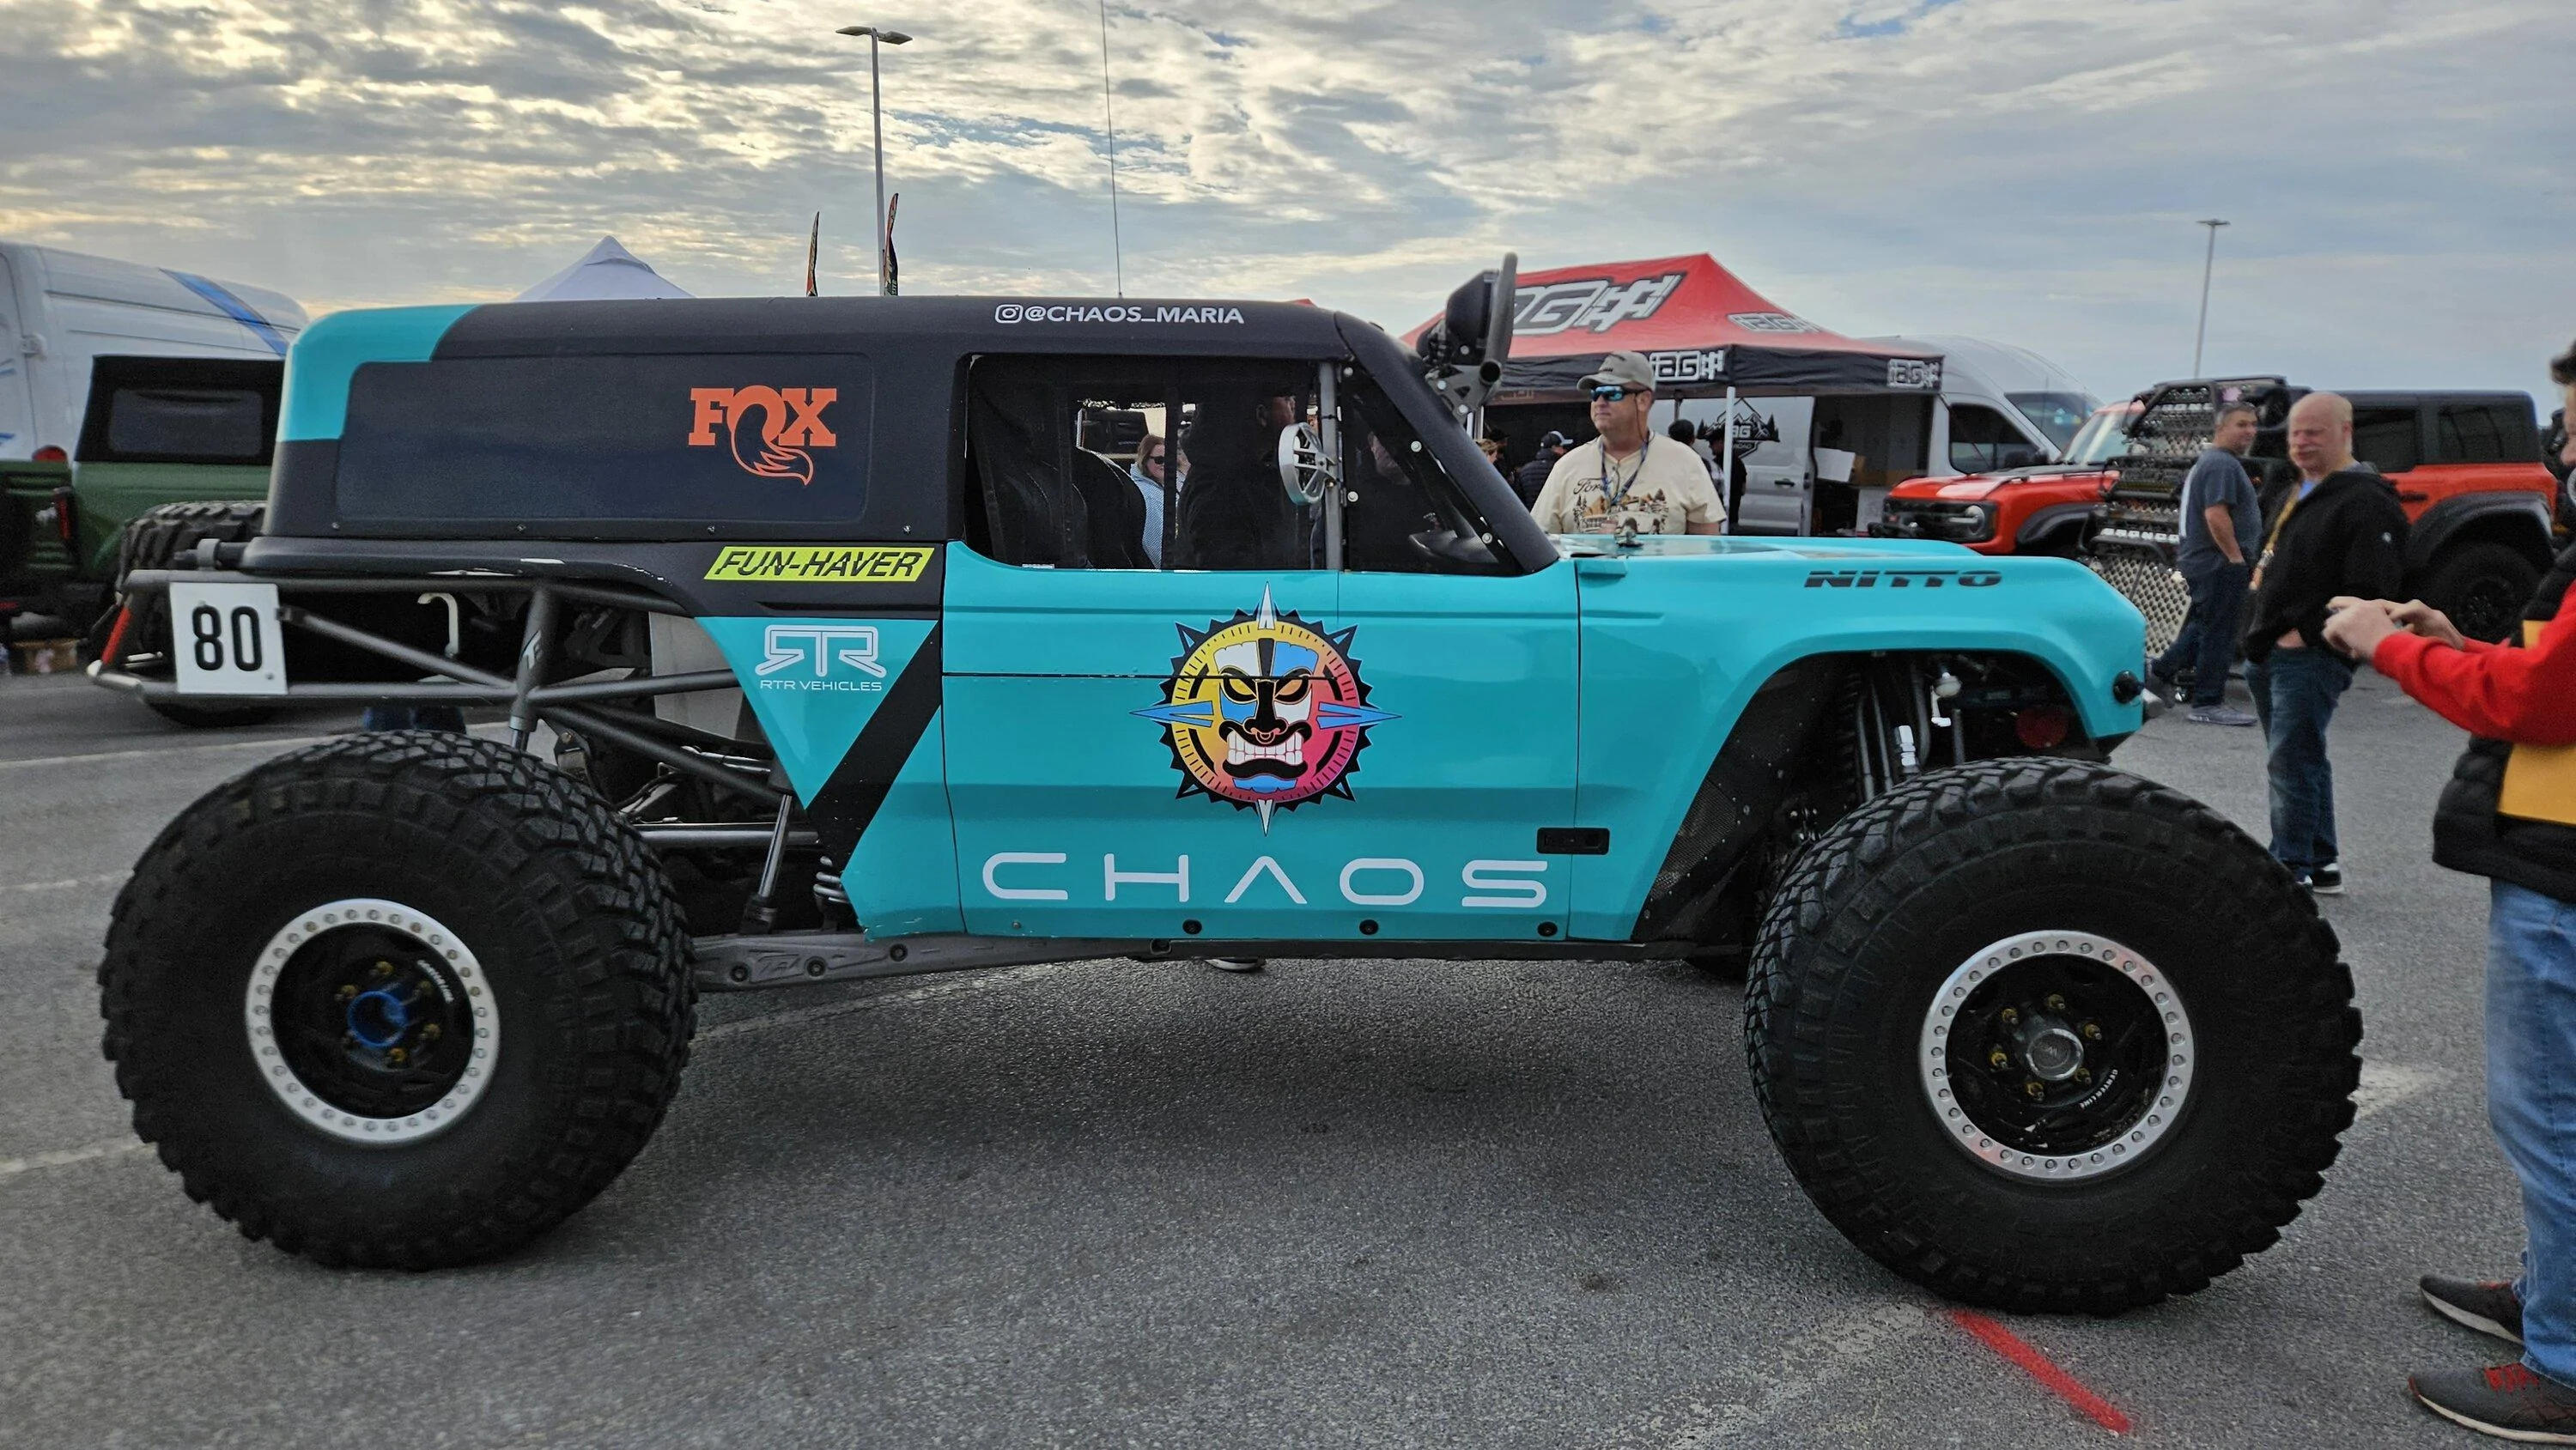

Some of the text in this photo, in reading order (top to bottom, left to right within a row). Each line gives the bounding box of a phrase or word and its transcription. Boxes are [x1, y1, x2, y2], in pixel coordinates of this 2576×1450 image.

[1024, 306, 1244, 324] @CHAOS_MARIA
[689, 385, 837, 486] FOX
[1573, 477, 1614, 494] For
[714, 550, 923, 577] FUN-HAVER
[1804, 570, 2002, 587] NITTO
[192, 605, 263, 672] 80
[760, 680, 883, 691] RTR VEHICLES
[982, 852, 1548, 907] CHAOS
